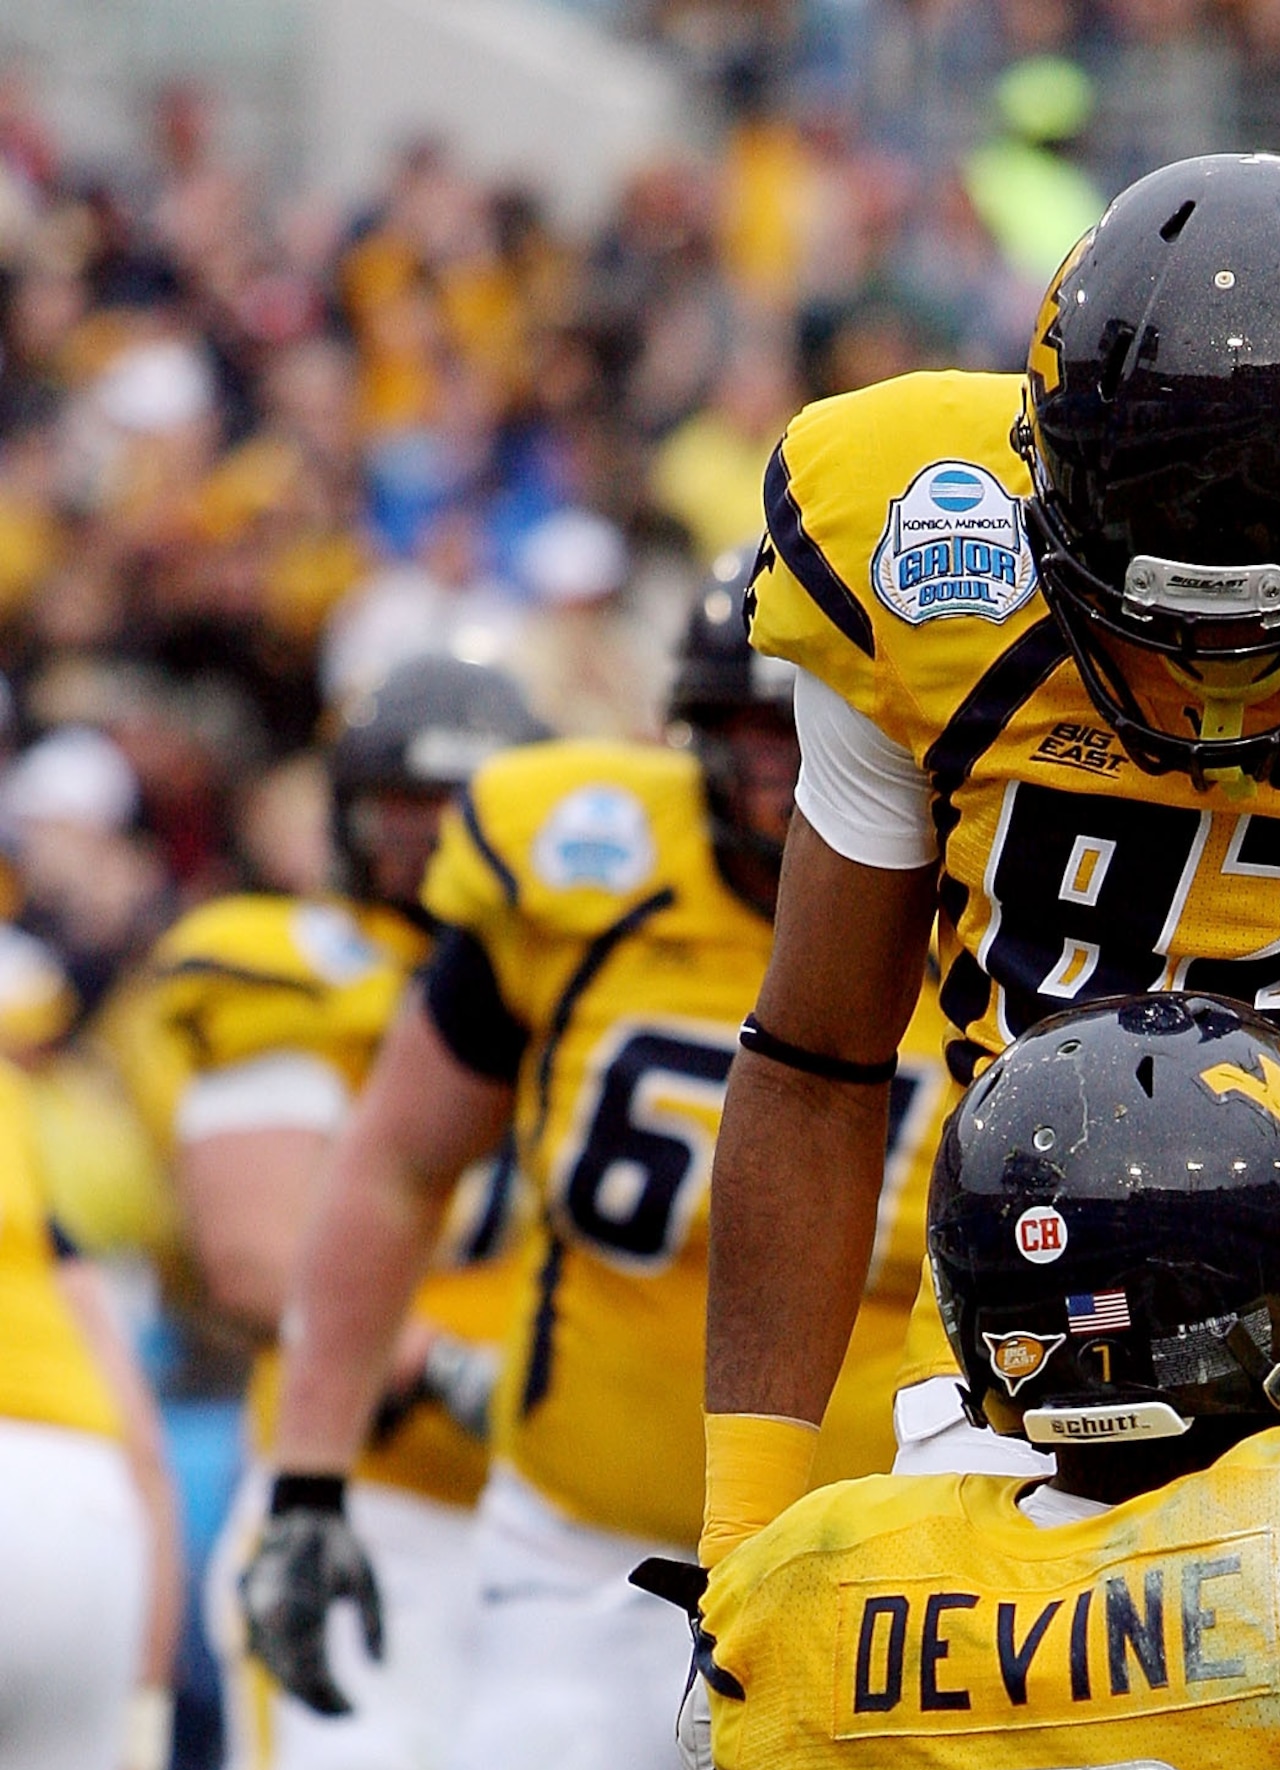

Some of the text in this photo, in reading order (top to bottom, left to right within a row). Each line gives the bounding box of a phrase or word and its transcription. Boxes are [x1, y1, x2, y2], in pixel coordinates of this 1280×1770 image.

[903, 519, 1012, 531] KONICA MINOLTA
[899, 536, 1017, 591] GATOR
[919, 580, 998, 607] BOWL
[1038, 722, 1129, 770] BIG EAST
[1020, 1218, 1062, 1252] CH
[853, 1556, 1248, 1713] DEVINE
